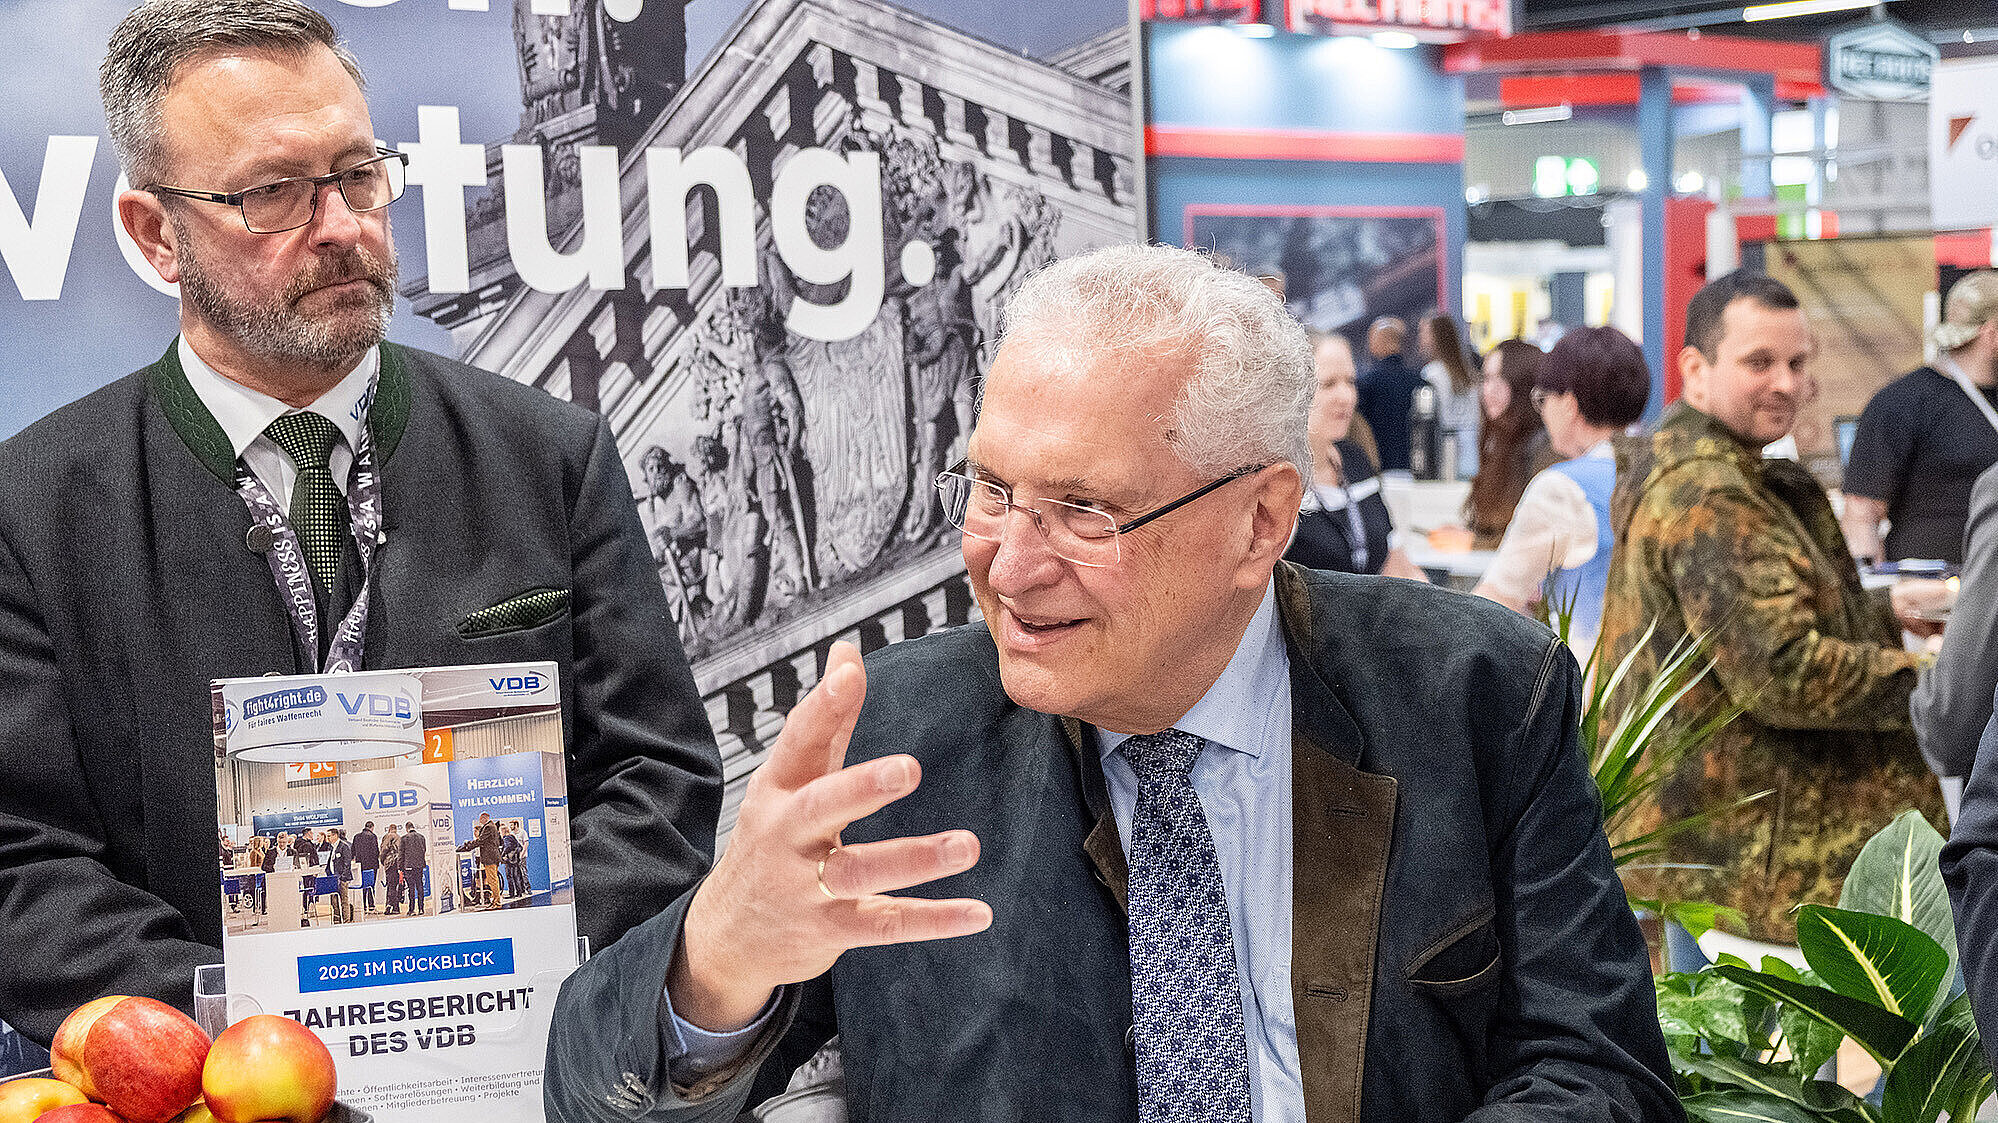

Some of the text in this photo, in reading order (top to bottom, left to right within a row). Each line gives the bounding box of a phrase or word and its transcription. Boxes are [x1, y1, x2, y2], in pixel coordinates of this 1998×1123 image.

[350, 379, 372, 421] VD
[256, 496, 273, 507] A
[360, 499, 375, 512] A
[265, 513, 286, 534] IS
[364, 519, 377, 539] IS
[274, 538, 317, 643] HAPPINESS
[489, 676, 540, 691] VDB
[246, 690, 322, 716] fight4right.de
[336, 692, 412, 720] VDB
[276, 709, 322, 723] Waffenrecht
[432, 734, 443, 758] 2
[358, 789, 419, 811] VDB
[432, 818, 450, 828] VDB
[318, 950, 495, 981] 2025 IM RÜCKBLICK
[349, 1024, 476, 1057] DES VDB
[363, 1078, 453, 1094] Öffentlichkeitsarbeit
[374, 1088, 453, 1102] Softwarelösungen
[461, 1079, 522, 1093] Weiterbildung
[524, 1077, 540, 1086] und
[386, 1093, 476, 1111] Mitgliederbetreuung
[483, 1088, 520, 1100] Projekte
